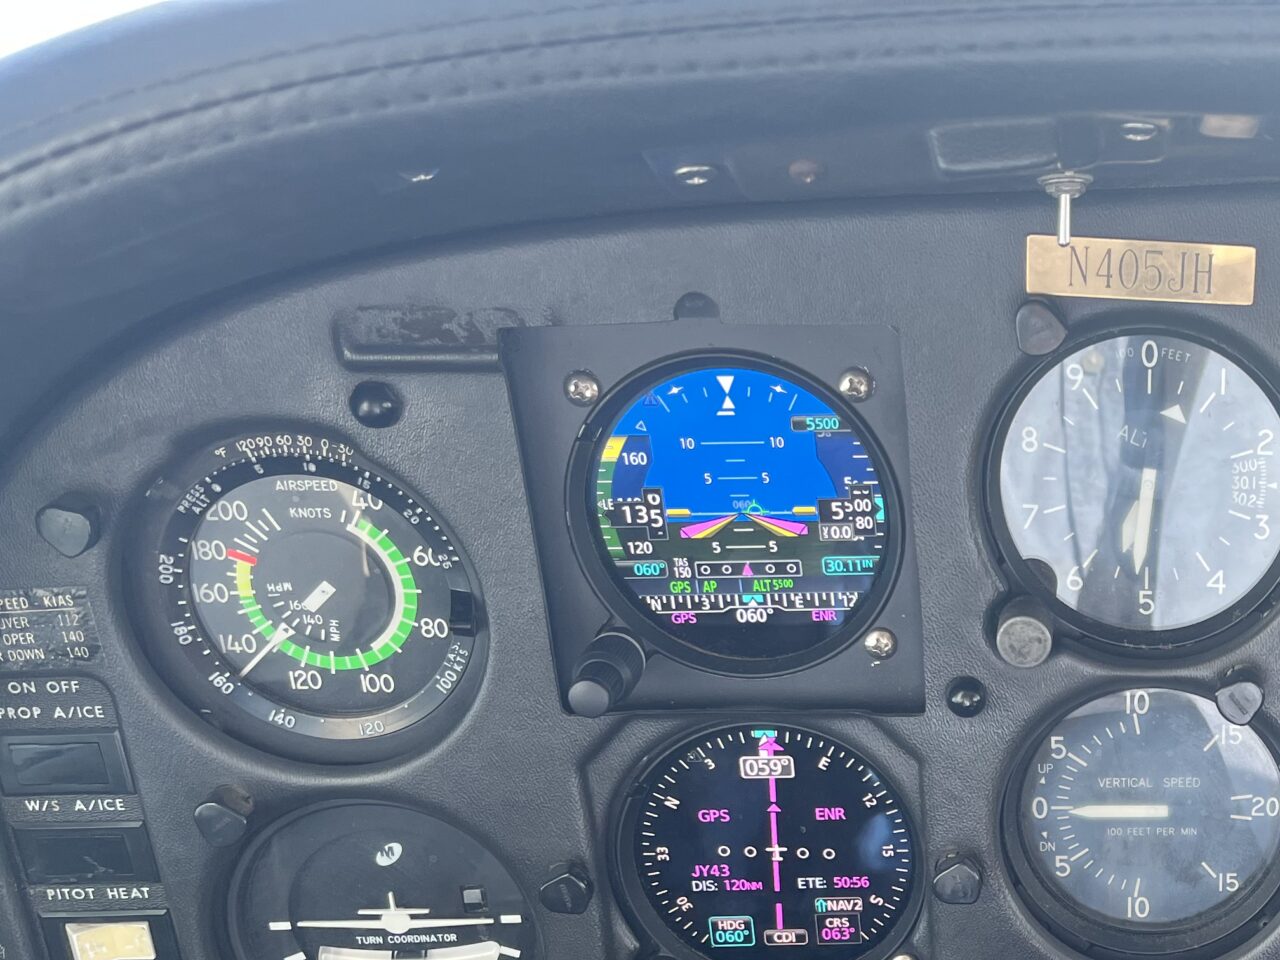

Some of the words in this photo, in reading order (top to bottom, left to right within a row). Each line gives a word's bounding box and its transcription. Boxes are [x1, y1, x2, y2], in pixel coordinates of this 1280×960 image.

[1068, 246, 1214, 295] N405JH
[806, 418, 840, 430] 5500
[275, 479, 338, 493] AIRSPEED
[289, 507, 332, 519] KNOTS
[192, 540, 227, 560] 180
[673, 558, 689, 567] TAS
[193, 584, 229, 603] 160
[670, 581, 692, 594] GPS
[43, 595, 74, 607] KIAS
[671, 612, 697, 624] GPS
[812, 610, 837, 621] ENR
[3, 631, 35, 644] OPER
[220, 634, 257, 654] 140
[9, 649, 45, 661] DOWN
[290, 670, 322, 690] 120
[360, 673, 395, 693] 100
[8, 681, 37, 694] ON
[46, 681, 80, 693] OFF
[54, 706, 105, 719] A/ICE
[1098, 777, 1152, 788] VERTICAL
[1163, 777, 1200, 788] SPEED
[25, 800, 60, 812] W/S
[74, 799, 125, 812] A/ICE
[698, 809, 730, 822] GPS
[815, 808, 846, 820] ENR
[1107, 828, 1123, 836] 100
[1127, 828, 1151, 836] FEET
[1156, 827, 1175, 836] PER
[1181, 827, 1197, 836] MIN
[691, 864, 730, 877] JY43
[692, 880, 718, 892] DIS:
[798, 877, 827, 889] ETE:
[833, 876, 870, 888] 50:56
[46, 888, 95, 900] PITOT
[107, 887, 150, 899] HEAT
[827, 900, 862, 911] NAV2
[718, 920, 745, 930] HDG
[825, 917, 850, 927] CRS
[356, 936, 383, 945] TURN
[388, 934, 457, 944] COORDINATOR
[773, 932, 795, 942] CDI
